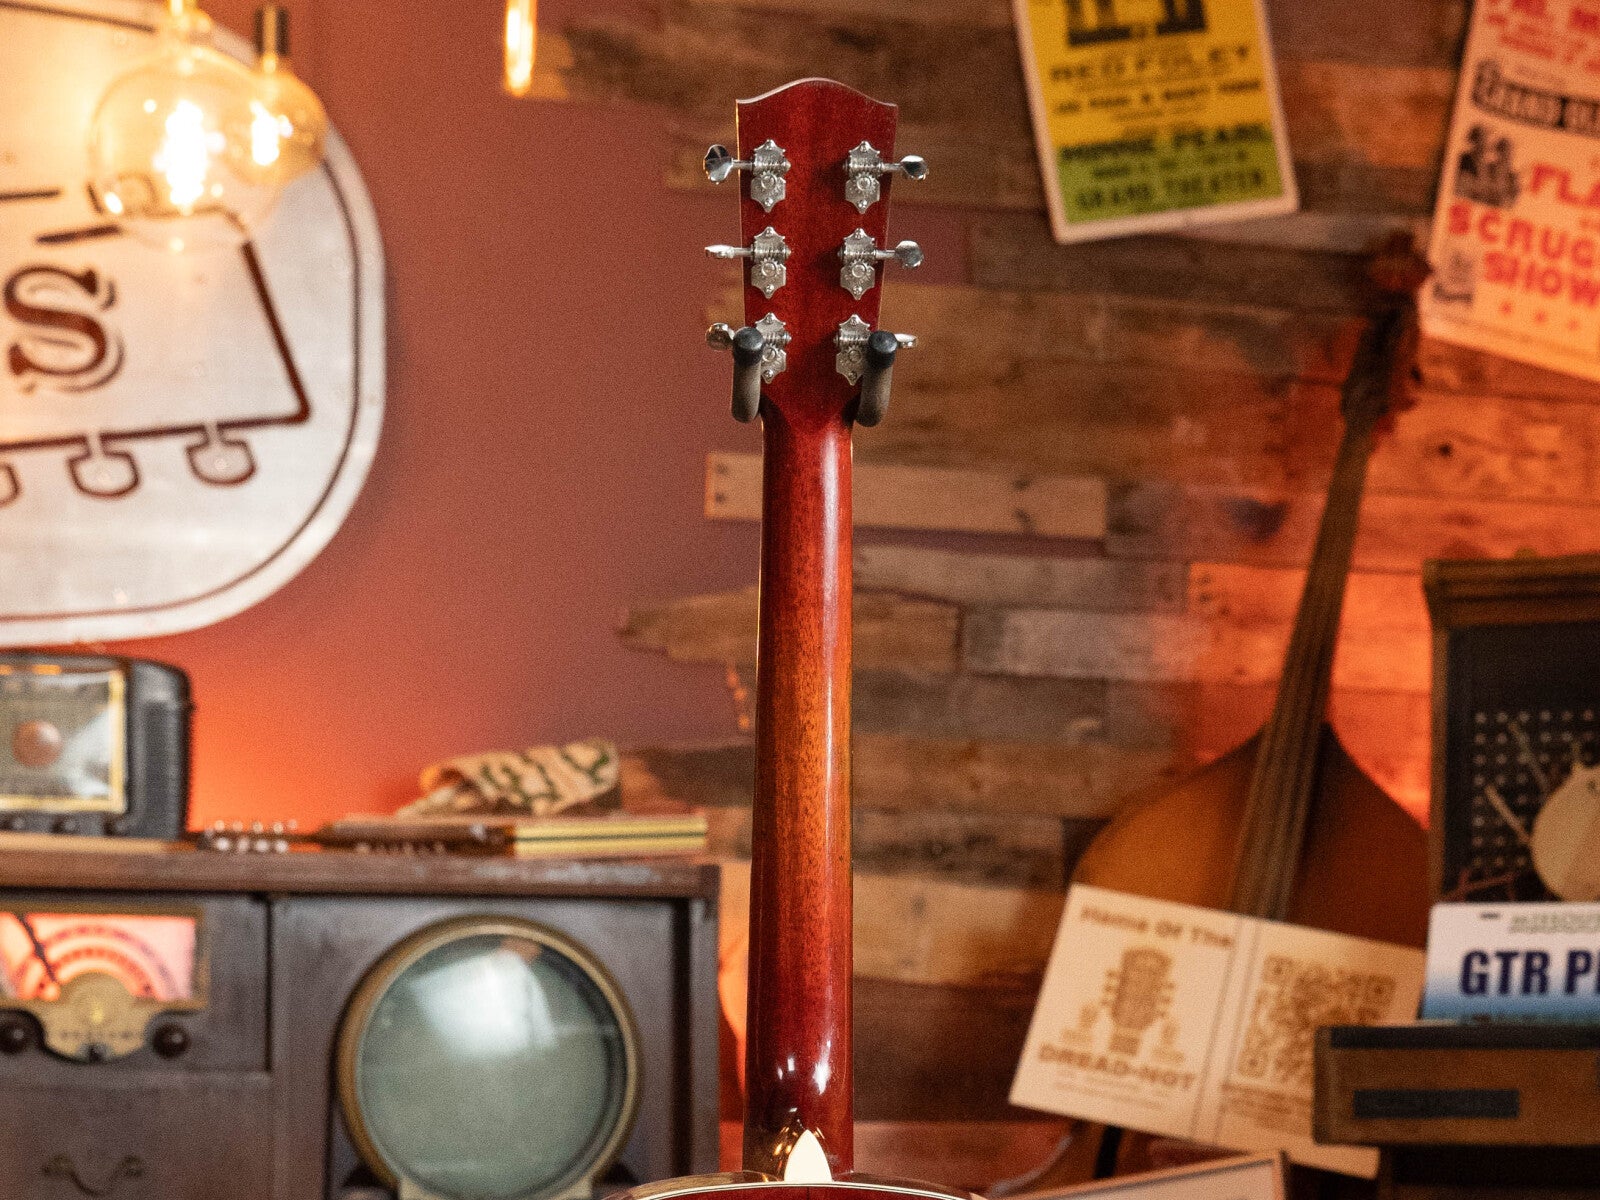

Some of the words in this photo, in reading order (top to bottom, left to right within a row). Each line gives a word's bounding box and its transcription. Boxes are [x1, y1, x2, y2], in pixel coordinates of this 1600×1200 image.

[1171, 121, 1268, 150] PEARL
[1076, 183, 1152, 210] GRAND
[3, 263, 124, 392] S
[1460, 950, 1549, 996] GTR
[1565, 950, 1600, 996] P
[1037, 1041, 1197, 1092] DREAD-NOT
